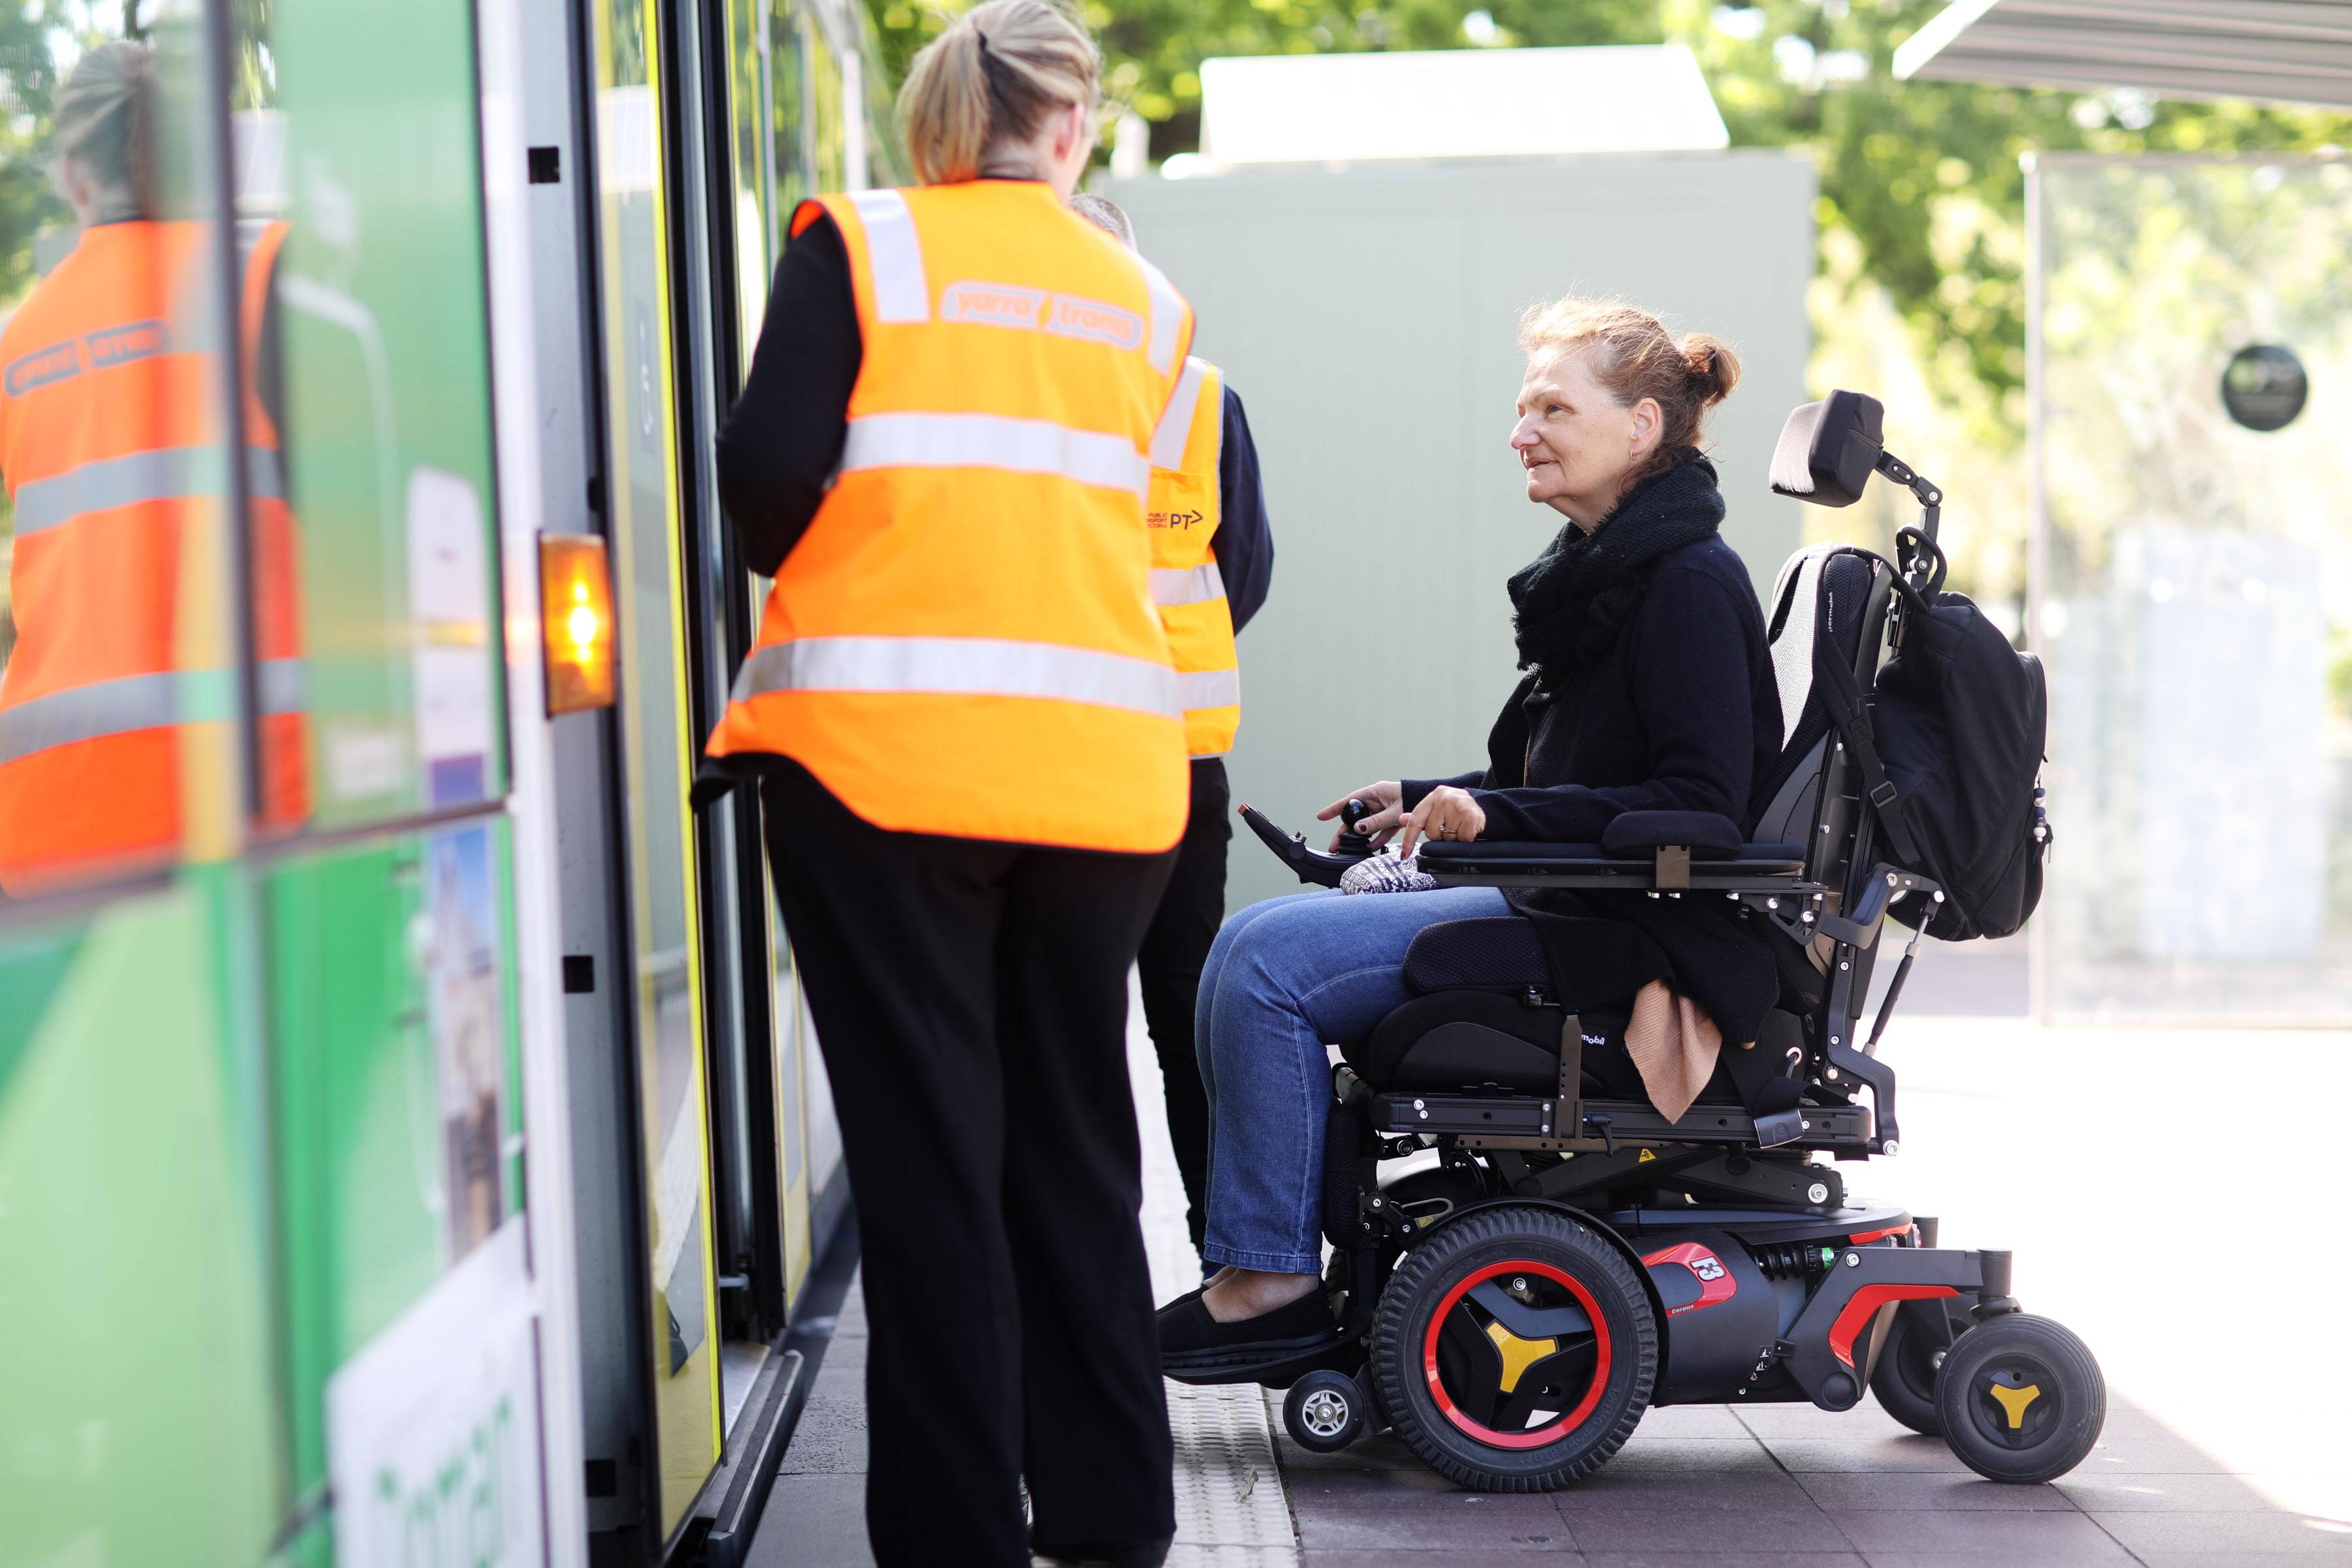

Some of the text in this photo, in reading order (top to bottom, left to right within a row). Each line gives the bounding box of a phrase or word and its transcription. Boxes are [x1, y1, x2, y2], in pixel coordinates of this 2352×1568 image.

[957, 291, 1032, 318] yarra
[1581, 1034, 1605, 1045] mobil
[1690, 1256, 1725, 1281] F3
[1671, 1304, 1694, 1314] Corpus
